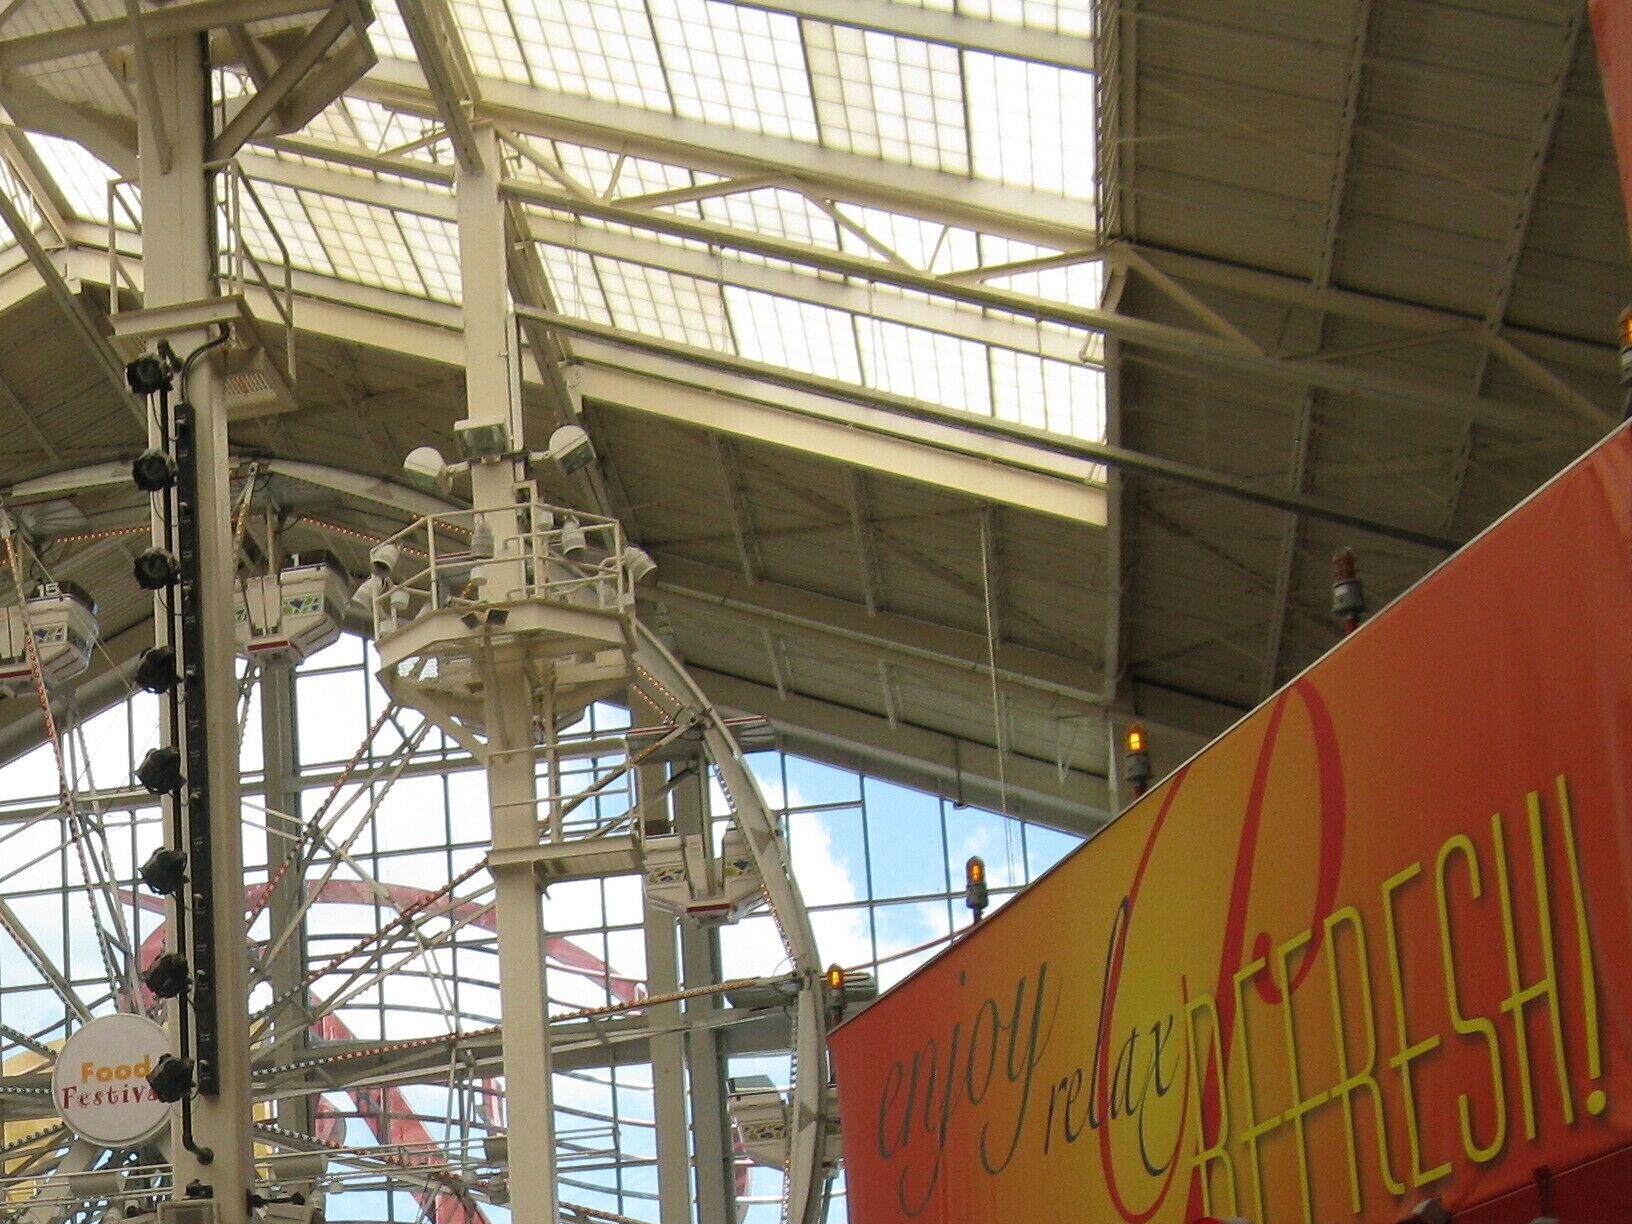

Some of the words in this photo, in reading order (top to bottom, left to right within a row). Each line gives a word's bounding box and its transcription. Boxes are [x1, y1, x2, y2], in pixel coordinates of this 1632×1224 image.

[35, 581, 59, 598] 15
[80, 1054, 151, 1084] Food
[878, 960, 1062, 1217] enjoy
[1044, 897, 1180, 1177] relax
[61, 1082, 161, 1110] Festiva
